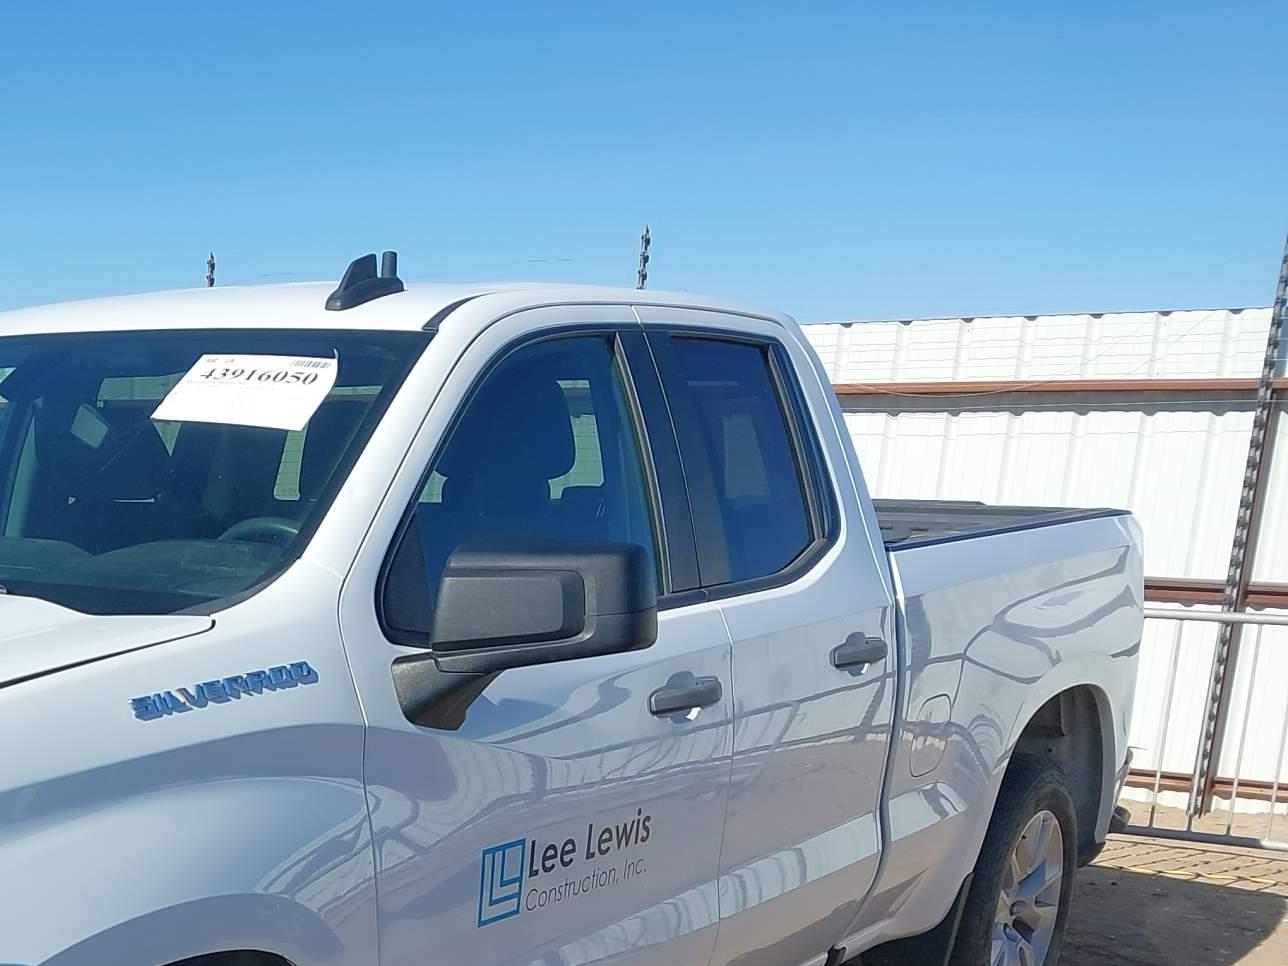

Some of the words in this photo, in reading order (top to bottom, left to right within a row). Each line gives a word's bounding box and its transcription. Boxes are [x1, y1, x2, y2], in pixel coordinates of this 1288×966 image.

[200, 367, 319, 386] 43916050
[129, 660, 320, 722] SILVERADO
[528, 839, 577, 878] Lee
[585, 807, 652, 860] Lewis
[525, 866, 620, 911] Construction,
[623, 857, 648, 882] Inc.
